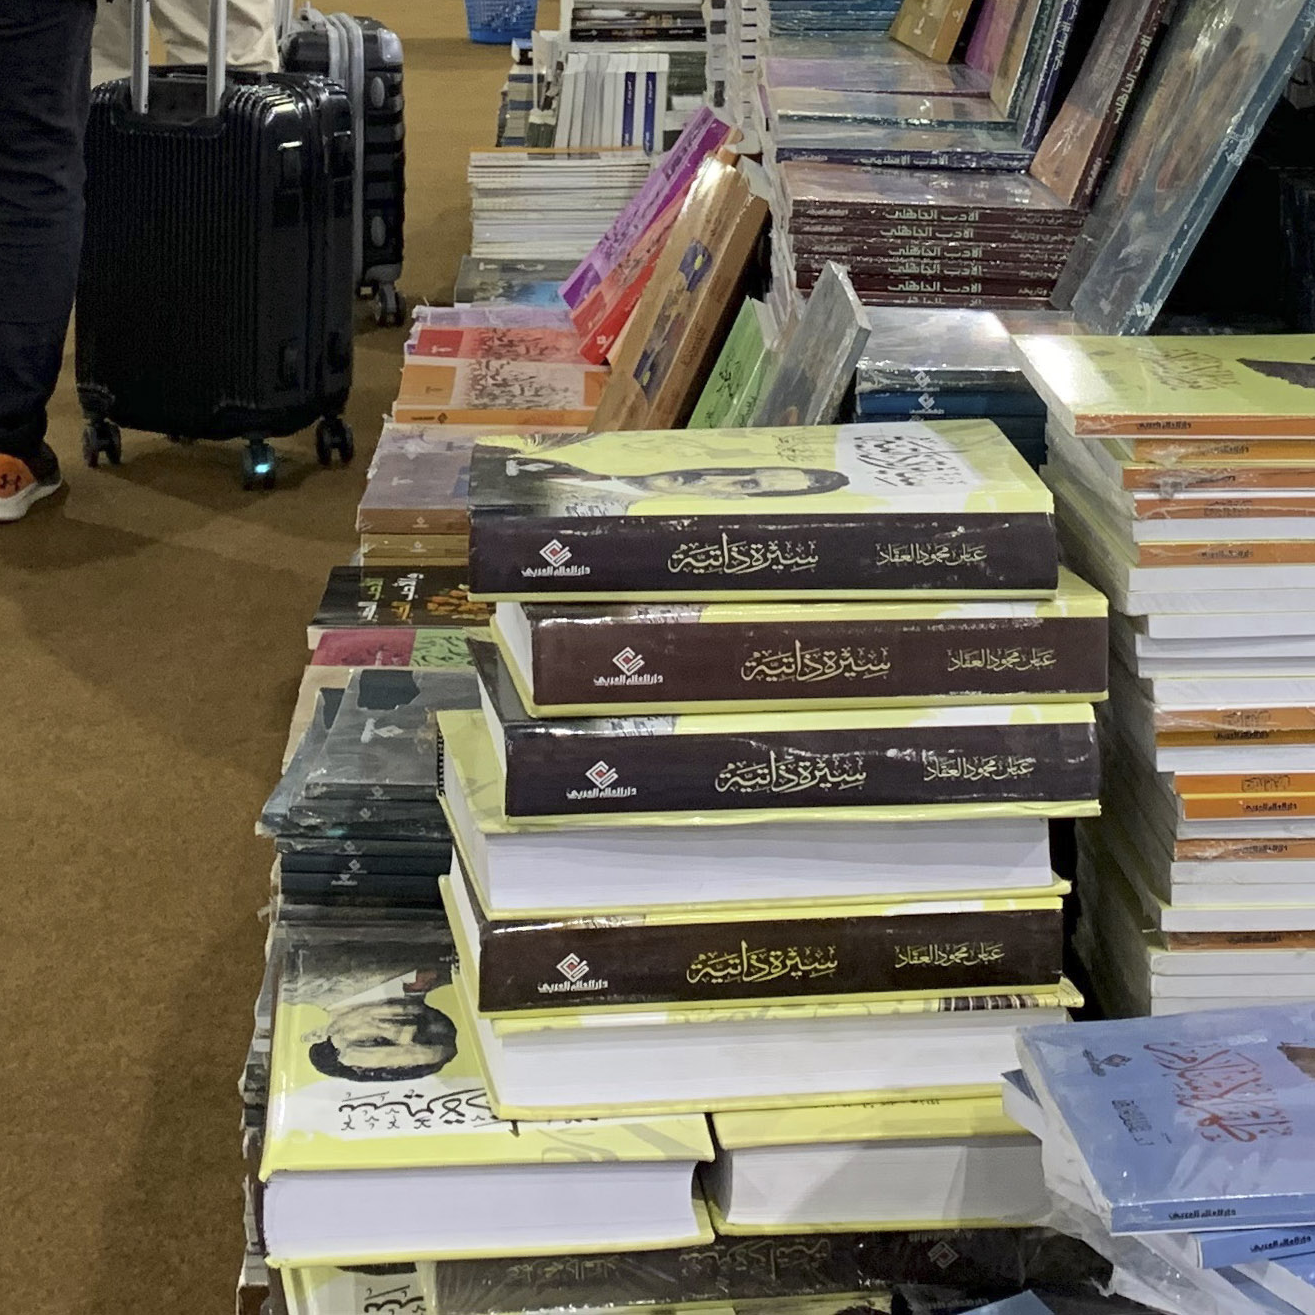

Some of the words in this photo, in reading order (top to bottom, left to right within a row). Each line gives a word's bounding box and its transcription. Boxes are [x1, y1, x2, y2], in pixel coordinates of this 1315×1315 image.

[885, 210, 938, 221] الجاهلي
[940, 211, 979, 222] الادب
[879, 227, 933, 238] الجاهلي
[935, 228, 974, 239] الادب
[888, 246, 941, 257] الجاهلي
[943, 246, 983, 258] الادب
[887, 263, 941, 276] الجاهلي
[943, 265, 983, 277] الادب
[887, 281, 941, 294] الجاهلي
[943, 283, 982, 295] الادب
[667, 531, 751, 574] ذاتية
[741, 538, 819, 574] سيرة
[876, 543, 921, 566] العقاد
[918, 542, 953, 566] محمود
[949, 542, 988, 566] عباس
[521, 565, 549, 577] العربي
[550, 564, 575, 577] العالم
[576, 564, 591, 576] دار
[740, 638, 824, 682] ذاتية
[812, 647, 890, 682] سيرة
[946, 650, 992, 673] العقاد
[989, 648, 1023, 673] محمود
[1019, 648, 1058, 672] عباس
[593, 675, 621, 687] العربي
[622, 674, 648, 687] العالم
[649, 674, 664, 686] دار
[715, 750, 798, 794] ذاتية
[922, 759, 968, 783] العقاد
[964, 756, 999, 783] محمود
[995, 754, 1036, 780] عباس
[787, 758, 867, 793] سيرة
[566, 787, 594, 800] العربي
[595, 786, 621, 800] العالم
[622, 786, 637, 799] دار
[893, 947, 939, 969] العقاد
[935, 944, 971, 967] محمود
[966, 941, 1006, 966] عباس
[686, 939, 771, 984] ذاتية
[759, 946, 838, 983] سيرة
[538, 981, 566, 994] العربي
[567, 980, 592, 994] العالم
[593, 980, 608, 993] دار
